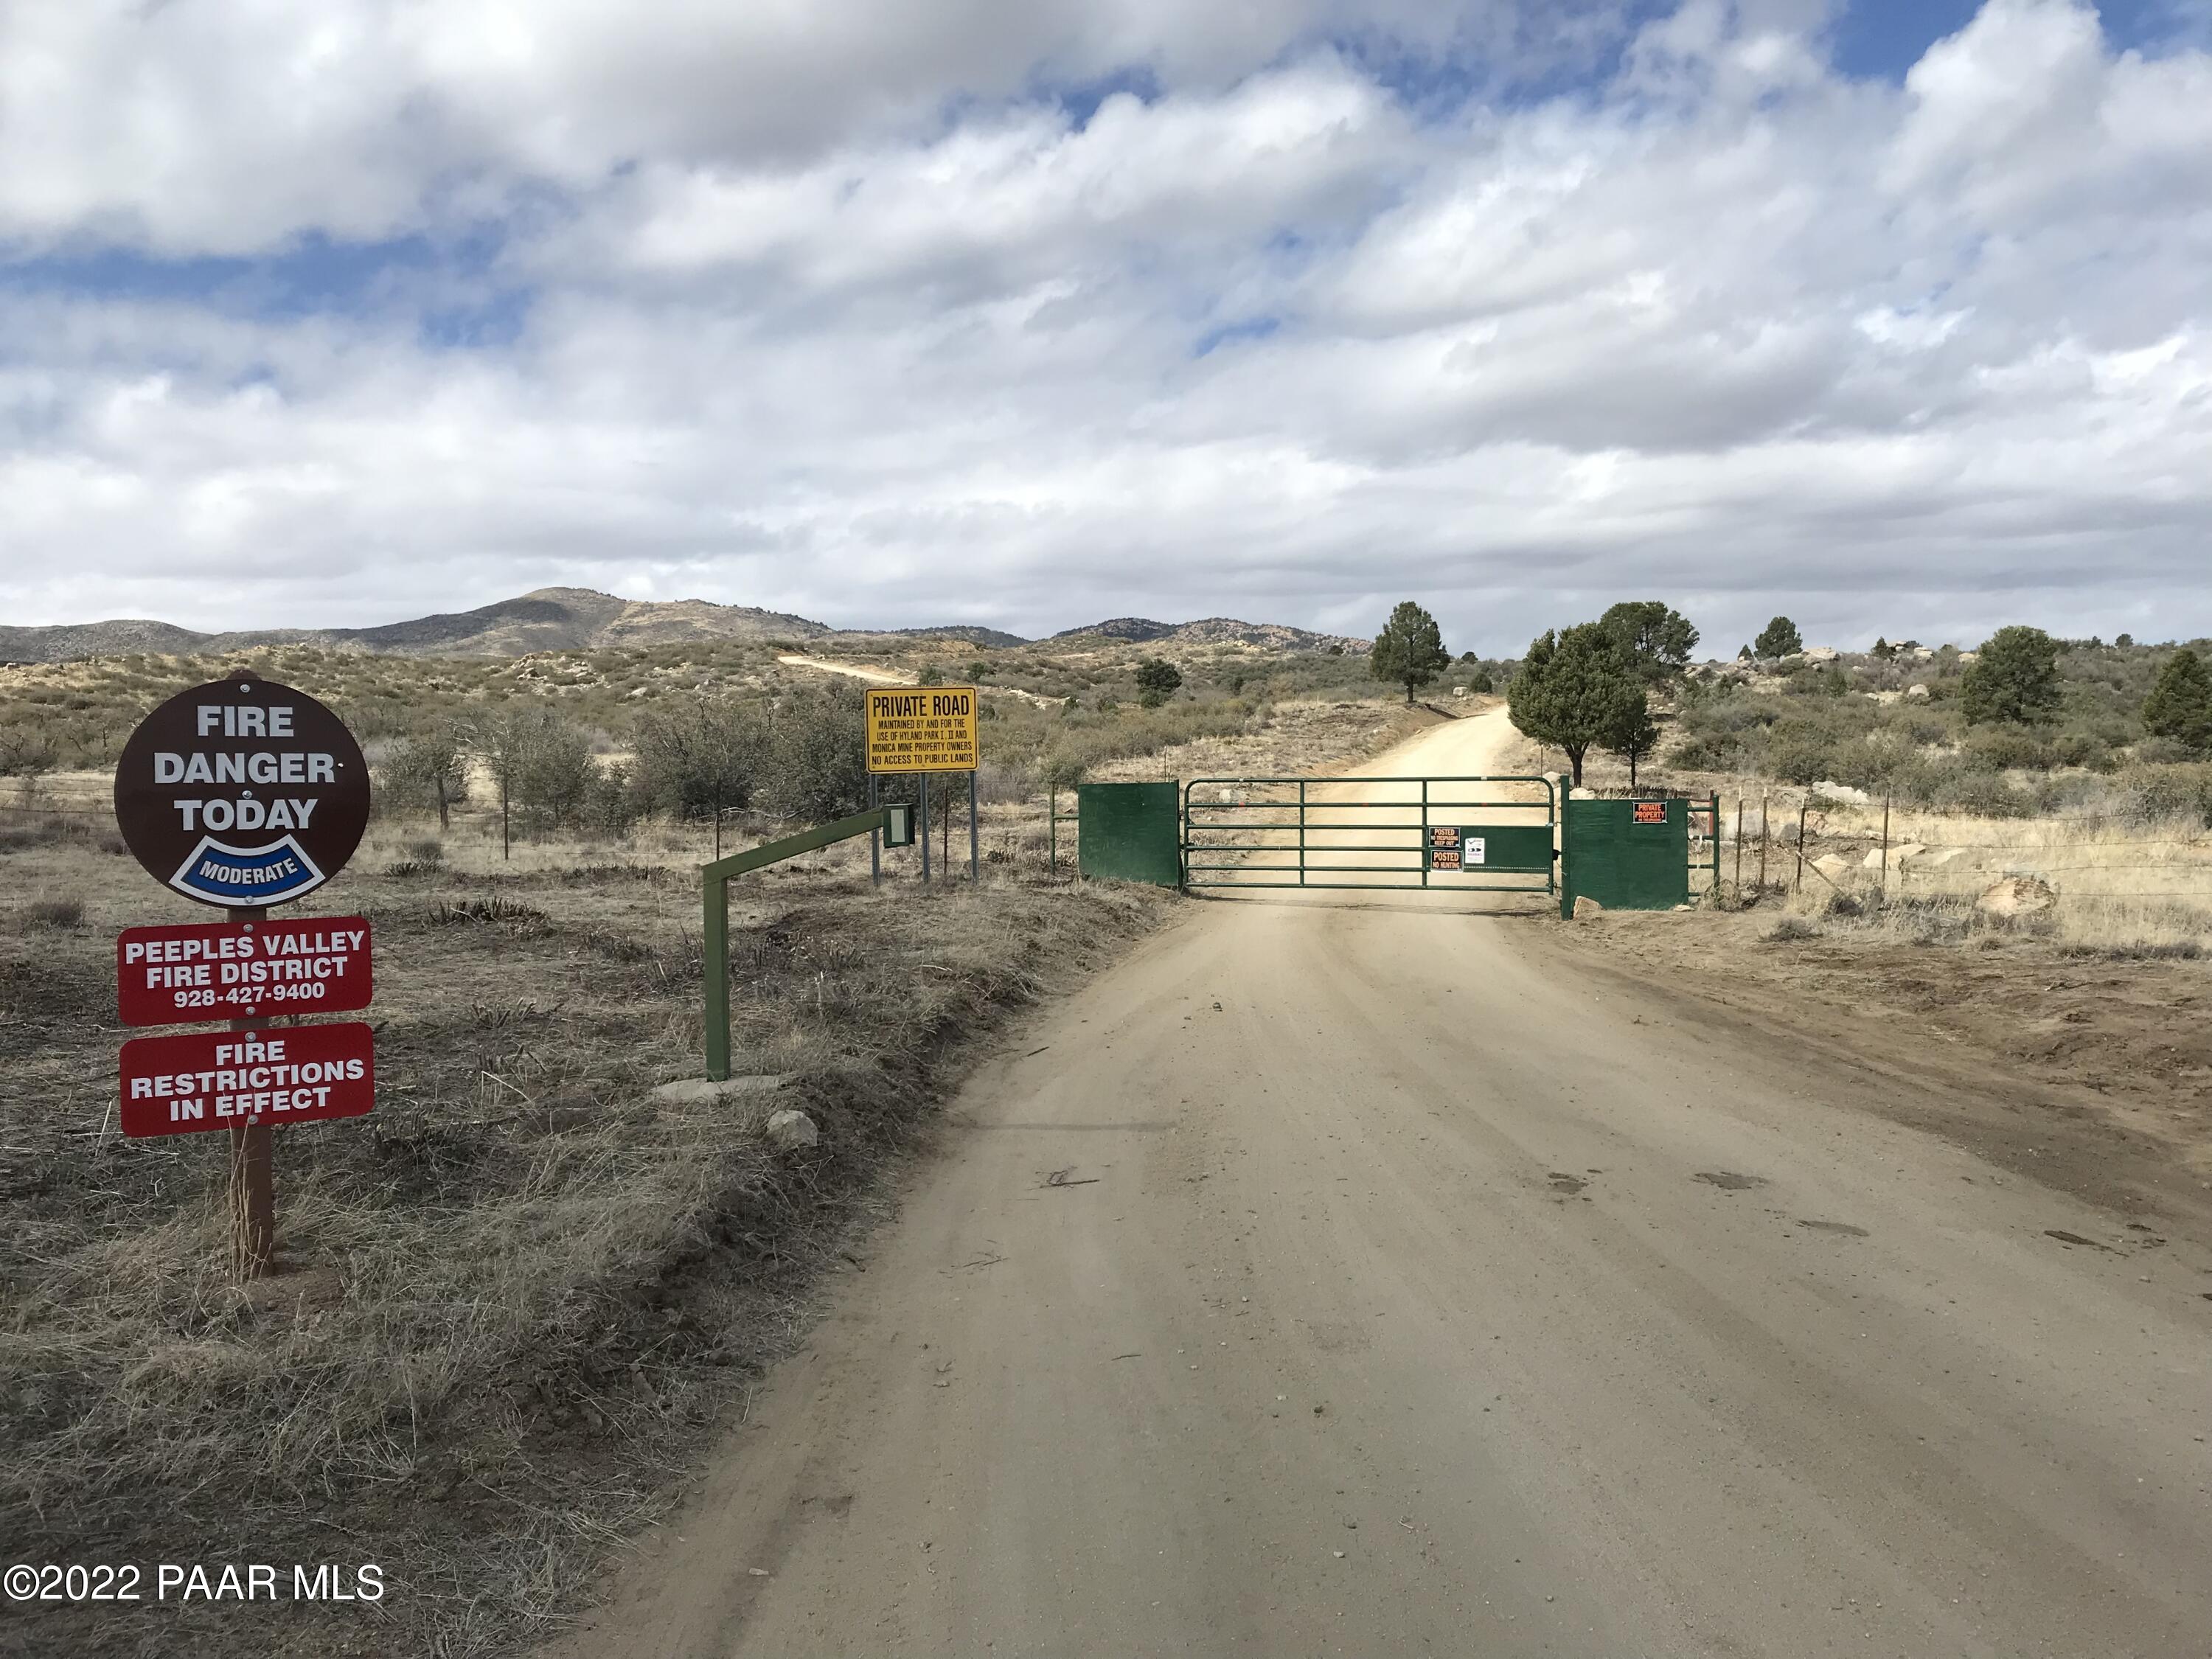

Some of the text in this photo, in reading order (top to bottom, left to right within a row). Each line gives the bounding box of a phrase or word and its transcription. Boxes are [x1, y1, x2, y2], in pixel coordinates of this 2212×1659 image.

[873, 695, 970, 717] PRIVATE ROAD
[197, 705, 294, 737] FIRE
[878, 718, 965, 730] MAINTAINED BY AND FOR THE
[872, 741, 973, 753] MONICA MINE PROPERTY OWNERS
[877, 731, 888, 741] USE
[890, 731, 898, 740] OF
[899, 731, 922, 740] HYLAND
[924, 731, 939, 740] PARK
[948, 730, 954, 740] II
[955, 730, 967, 740] AND
[153, 752, 335, 784] DANGER
[872, 753, 973, 765] NO ACCESS TO PUBLIC LANDS
[173, 799, 319, 831] TODAY
[1635, 810, 1665, 818] PROPERTY
[198, 857, 299, 885] MODERATE
[1433, 852, 1459, 862] POSTED
[125, 930, 365, 964] PEEPLES VALLEY
[146, 956, 348, 990] FIRE DISTRICT
[173, 981, 325, 1009] 928-427-9400
[215, 1040, 286, 1066] FIRE
[131, 1059, 365, 1100] RESTRICTIONS
[170, 1087, 332, 1122] IN EFFECT
